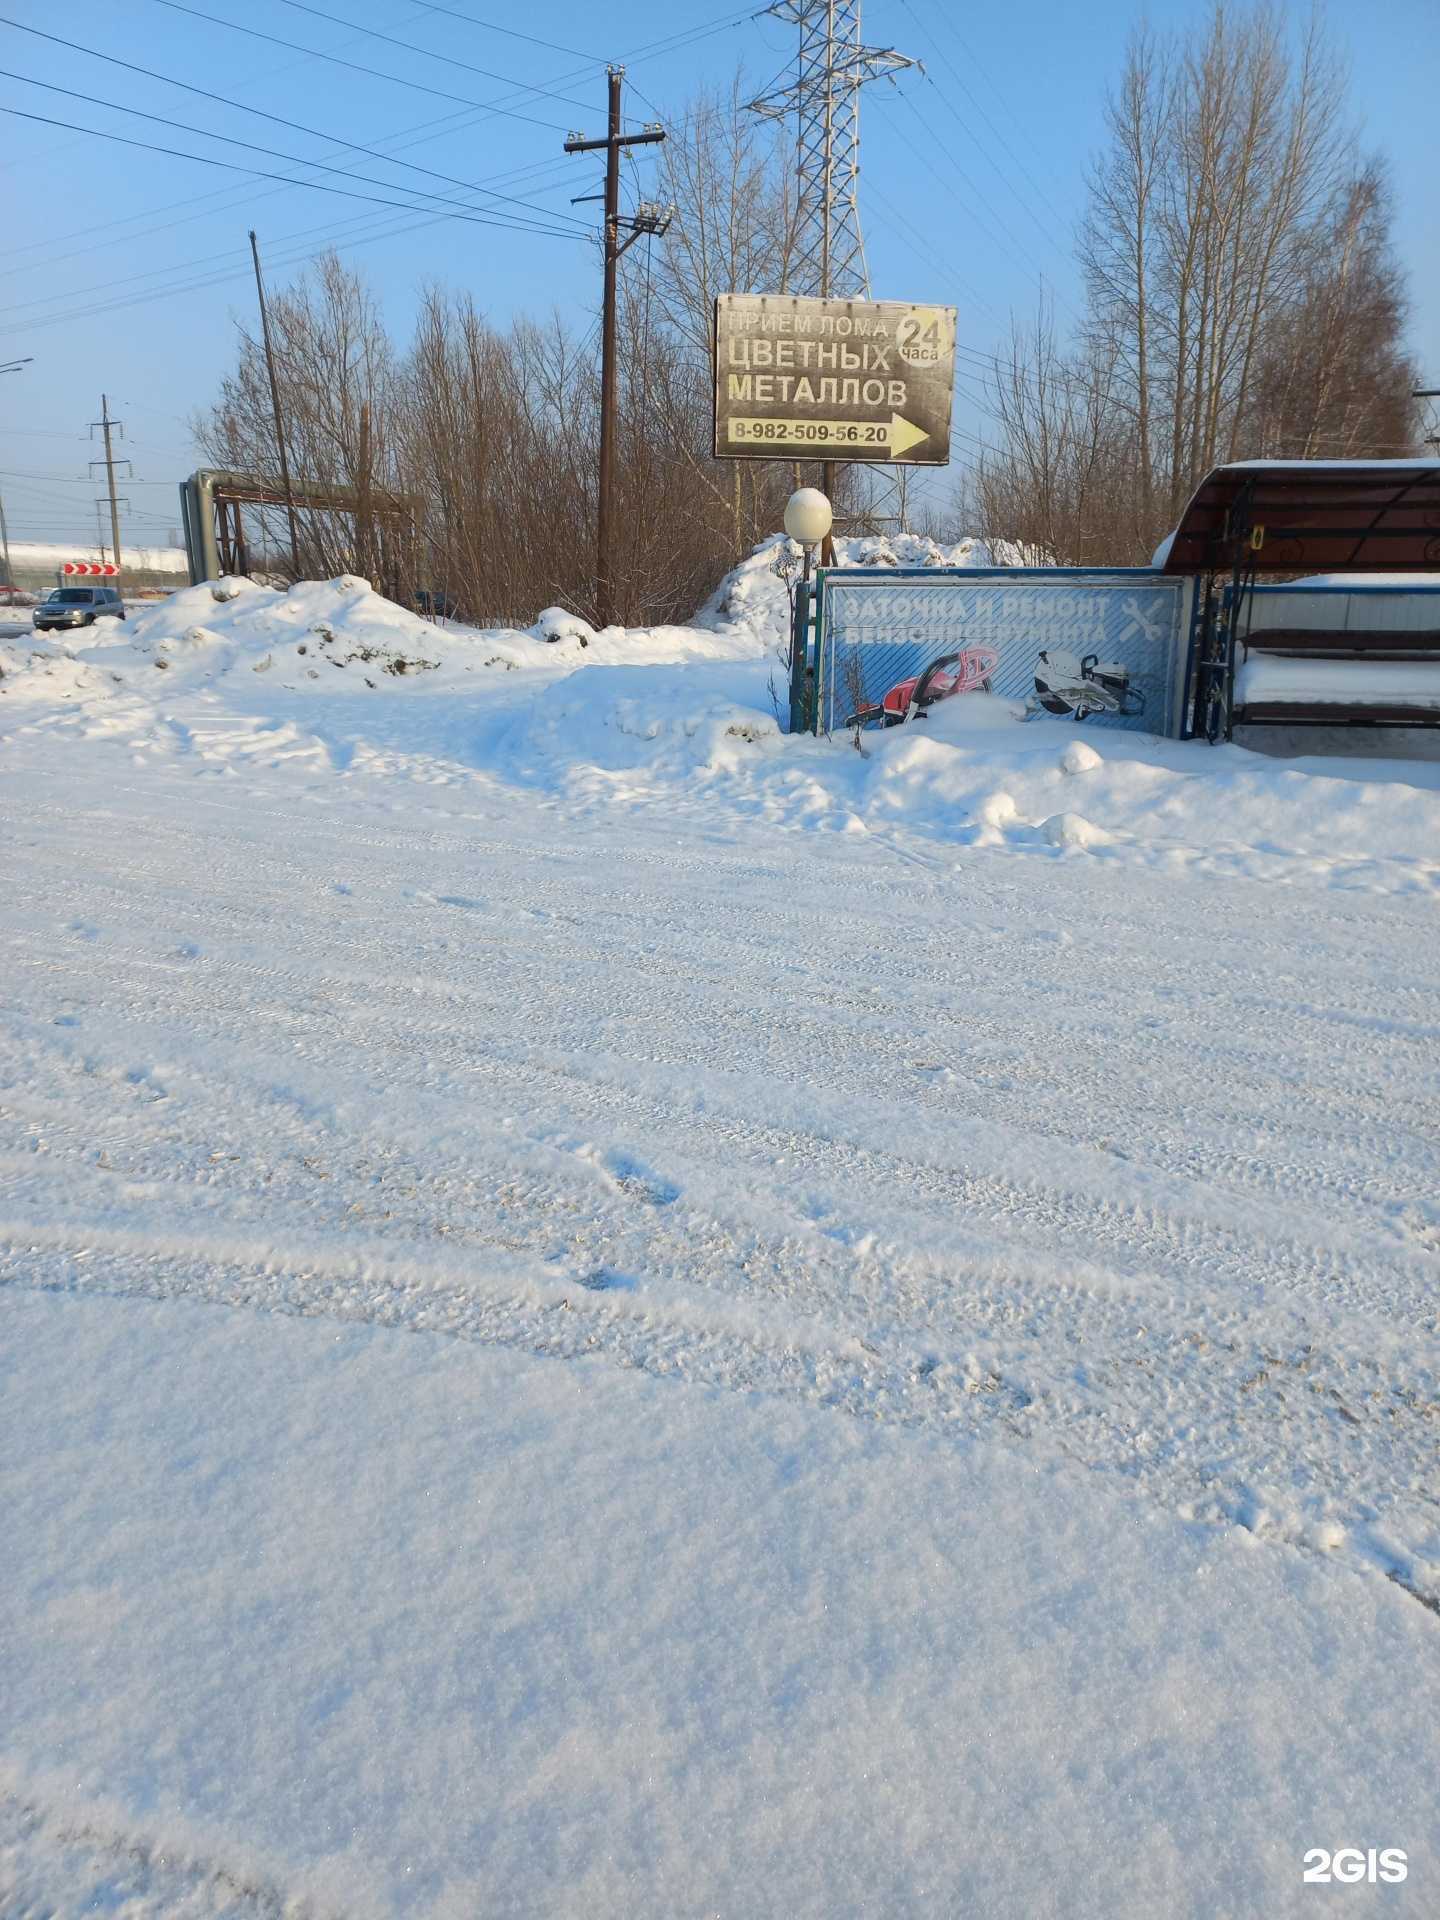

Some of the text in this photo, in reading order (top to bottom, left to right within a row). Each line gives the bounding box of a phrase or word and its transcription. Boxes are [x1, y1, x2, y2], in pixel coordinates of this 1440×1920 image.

[820, 316, 888, 337] ЛОМА
[903, 320, 941, 348] 24
[728, 337, 891, 370] ЦВЕТНЫХ
[901, 348, 939, 361] часа
[728, 374, 907, 406] МЕТАЛЛОВ
[735, 423, 887, 443] 8-982-509-56-20
[845, 597, 1110, 619] ЗАТОЧКА И РЕМОНТ
